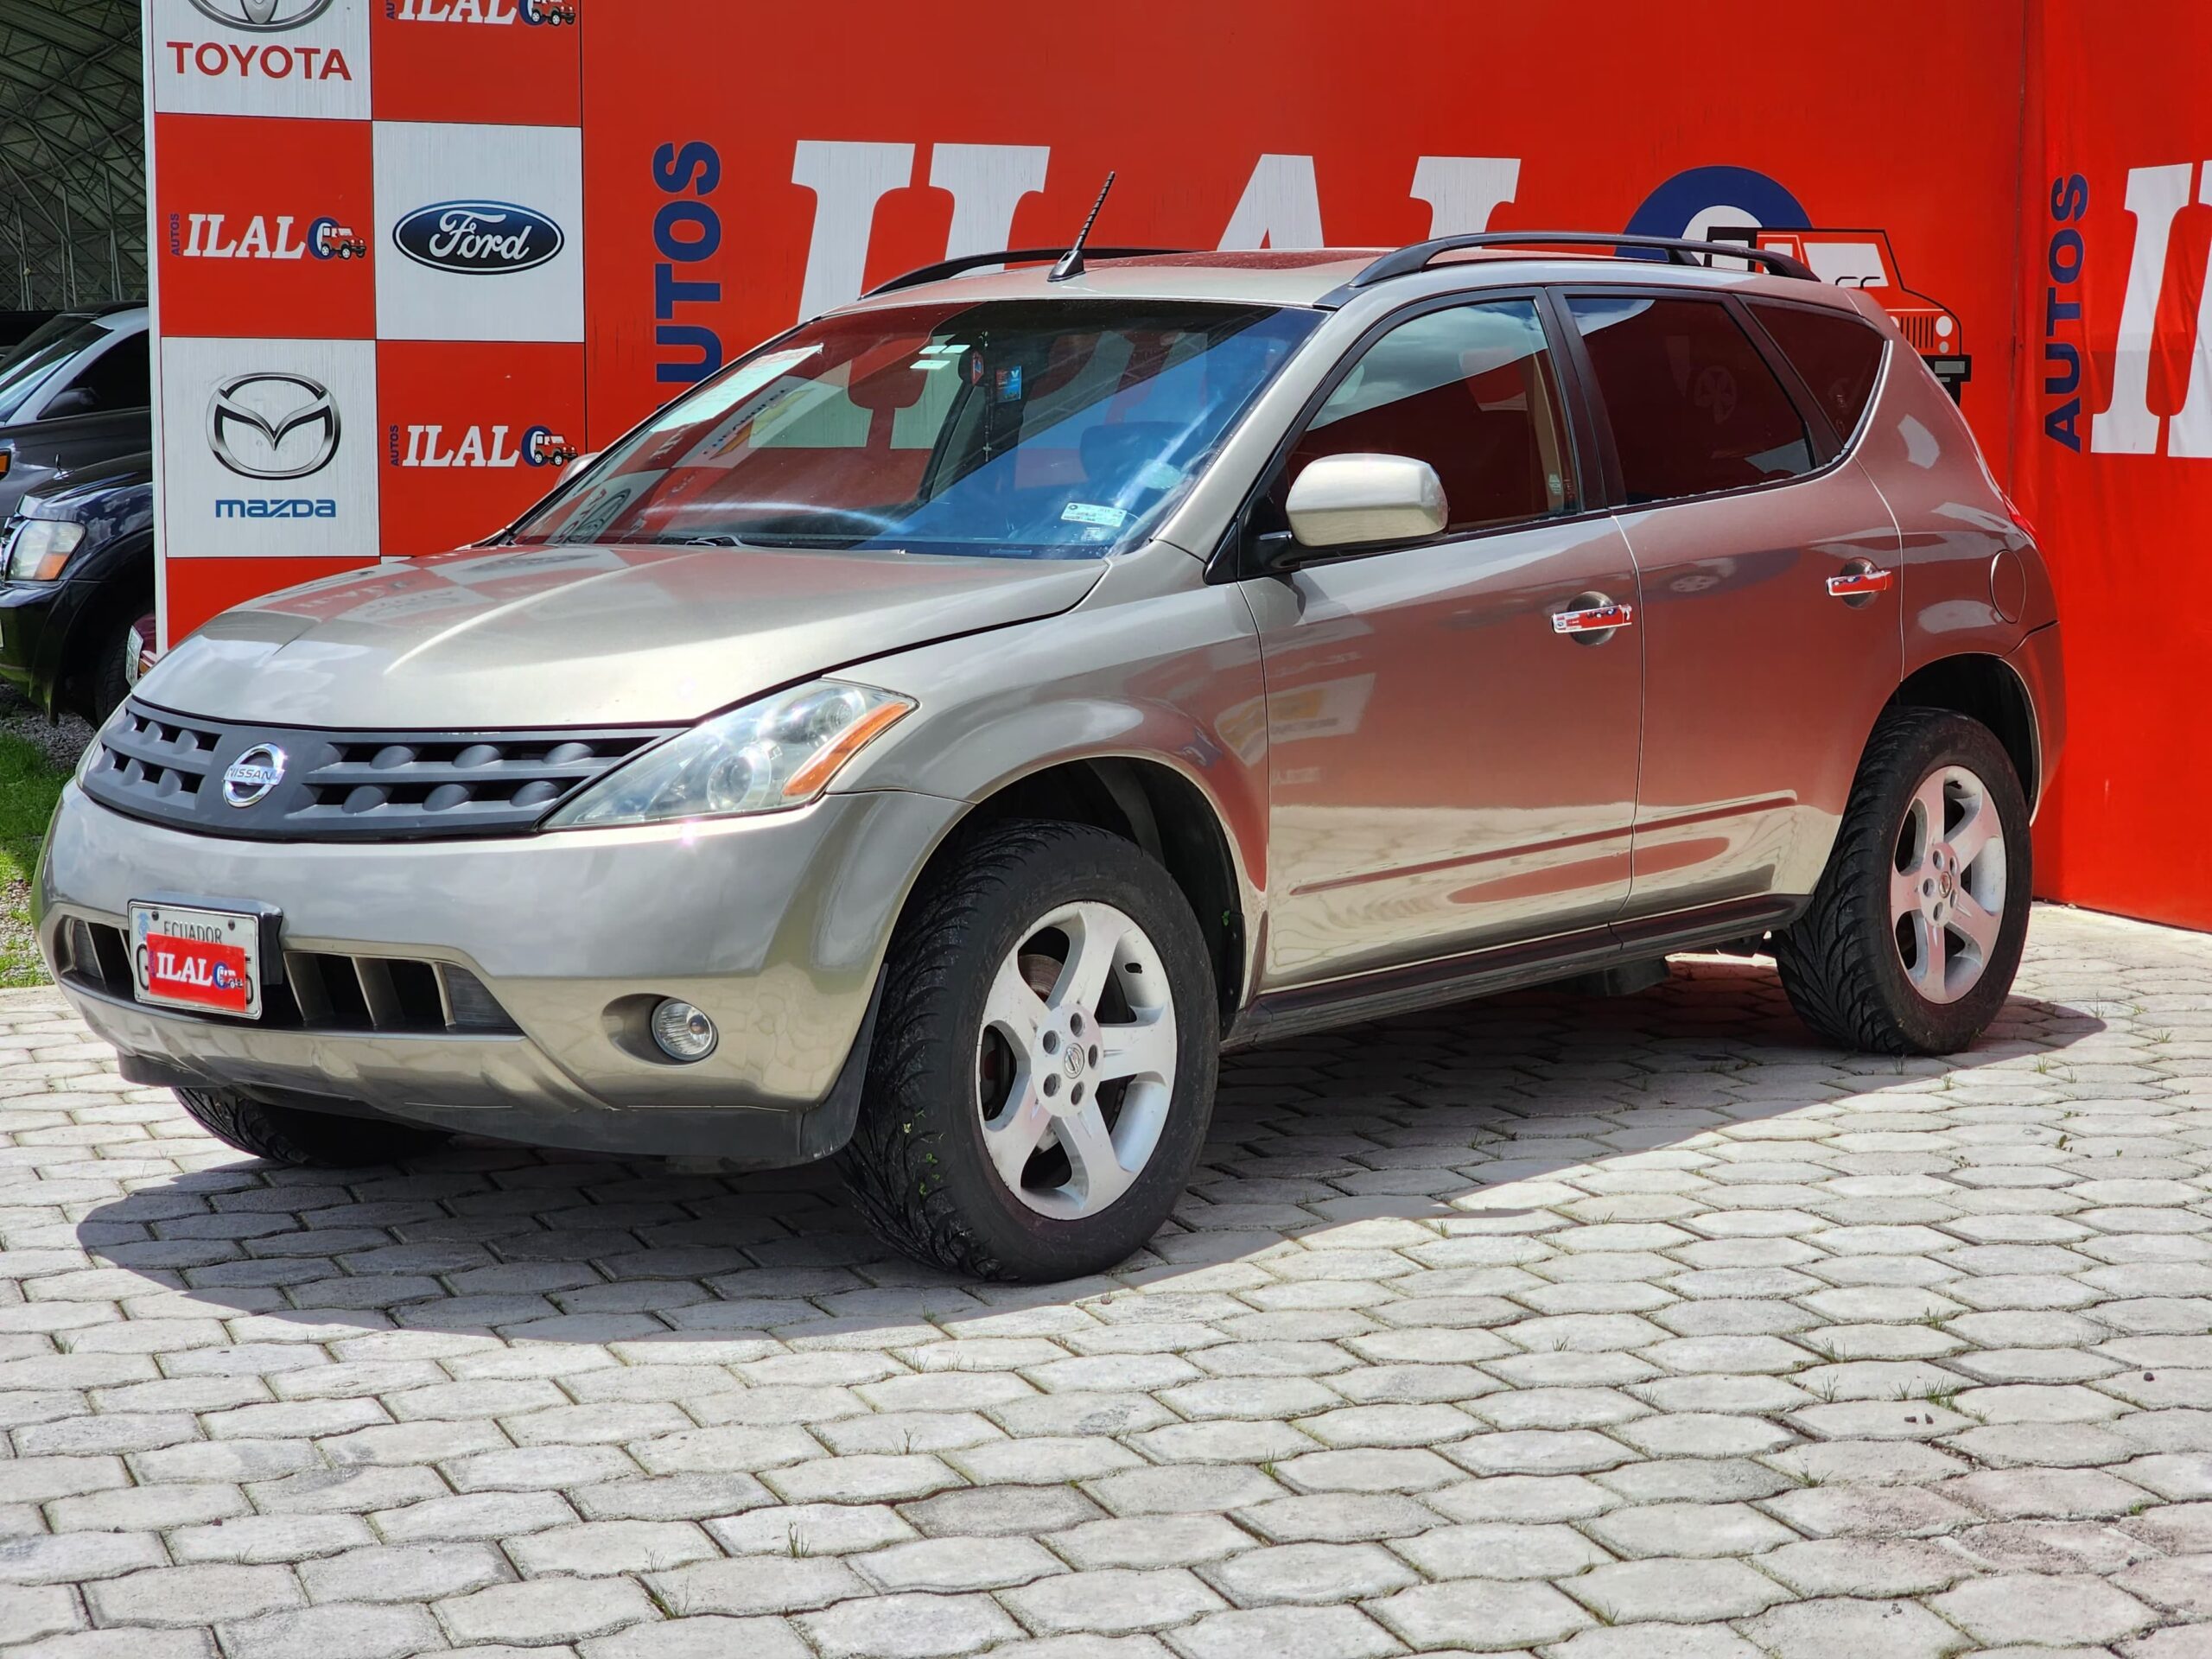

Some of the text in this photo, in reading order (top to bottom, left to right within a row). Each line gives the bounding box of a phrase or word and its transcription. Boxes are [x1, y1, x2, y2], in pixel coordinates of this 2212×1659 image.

[167, 41, 353, 80] TOYOTA
[169, 213, 181, 257] AUTOS
[429, 210, 532, 261] Ford
[652, 140, 721, 410] UTOS
[2044, 173, 2089, 453] AUTOS
[390, 424, 399, 467] AUTOS
[215, 499, 336, 518] mazda
[226, 767, 274, 780] NISSAN
[163, 920, 223, 944] ECUADOR
